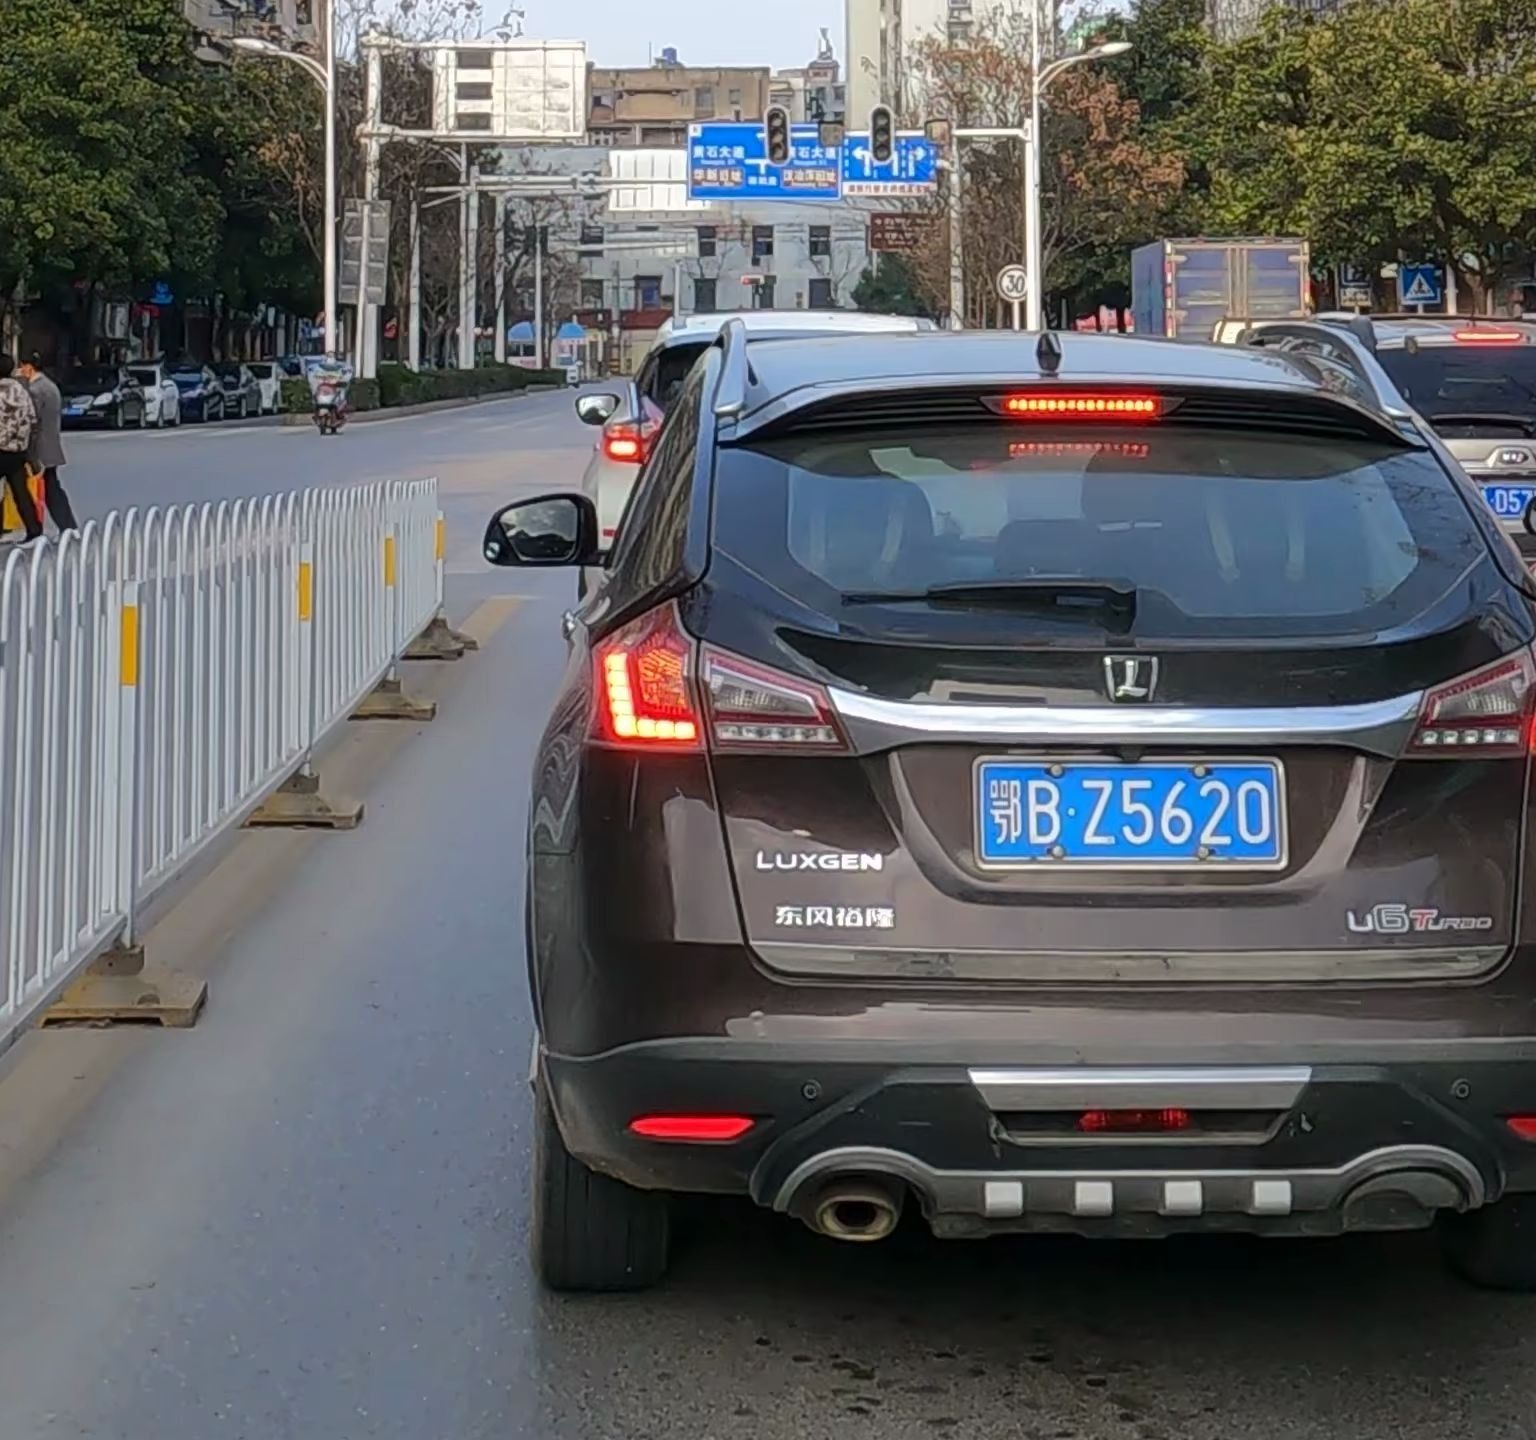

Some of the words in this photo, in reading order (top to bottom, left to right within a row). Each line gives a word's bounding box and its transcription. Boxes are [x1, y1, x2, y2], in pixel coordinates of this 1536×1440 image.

[1006, 274, 1024, 294] 30
[756, 850, 883, 871] LUXGEN
[775, 906, 895, 928] 东风裕隆
